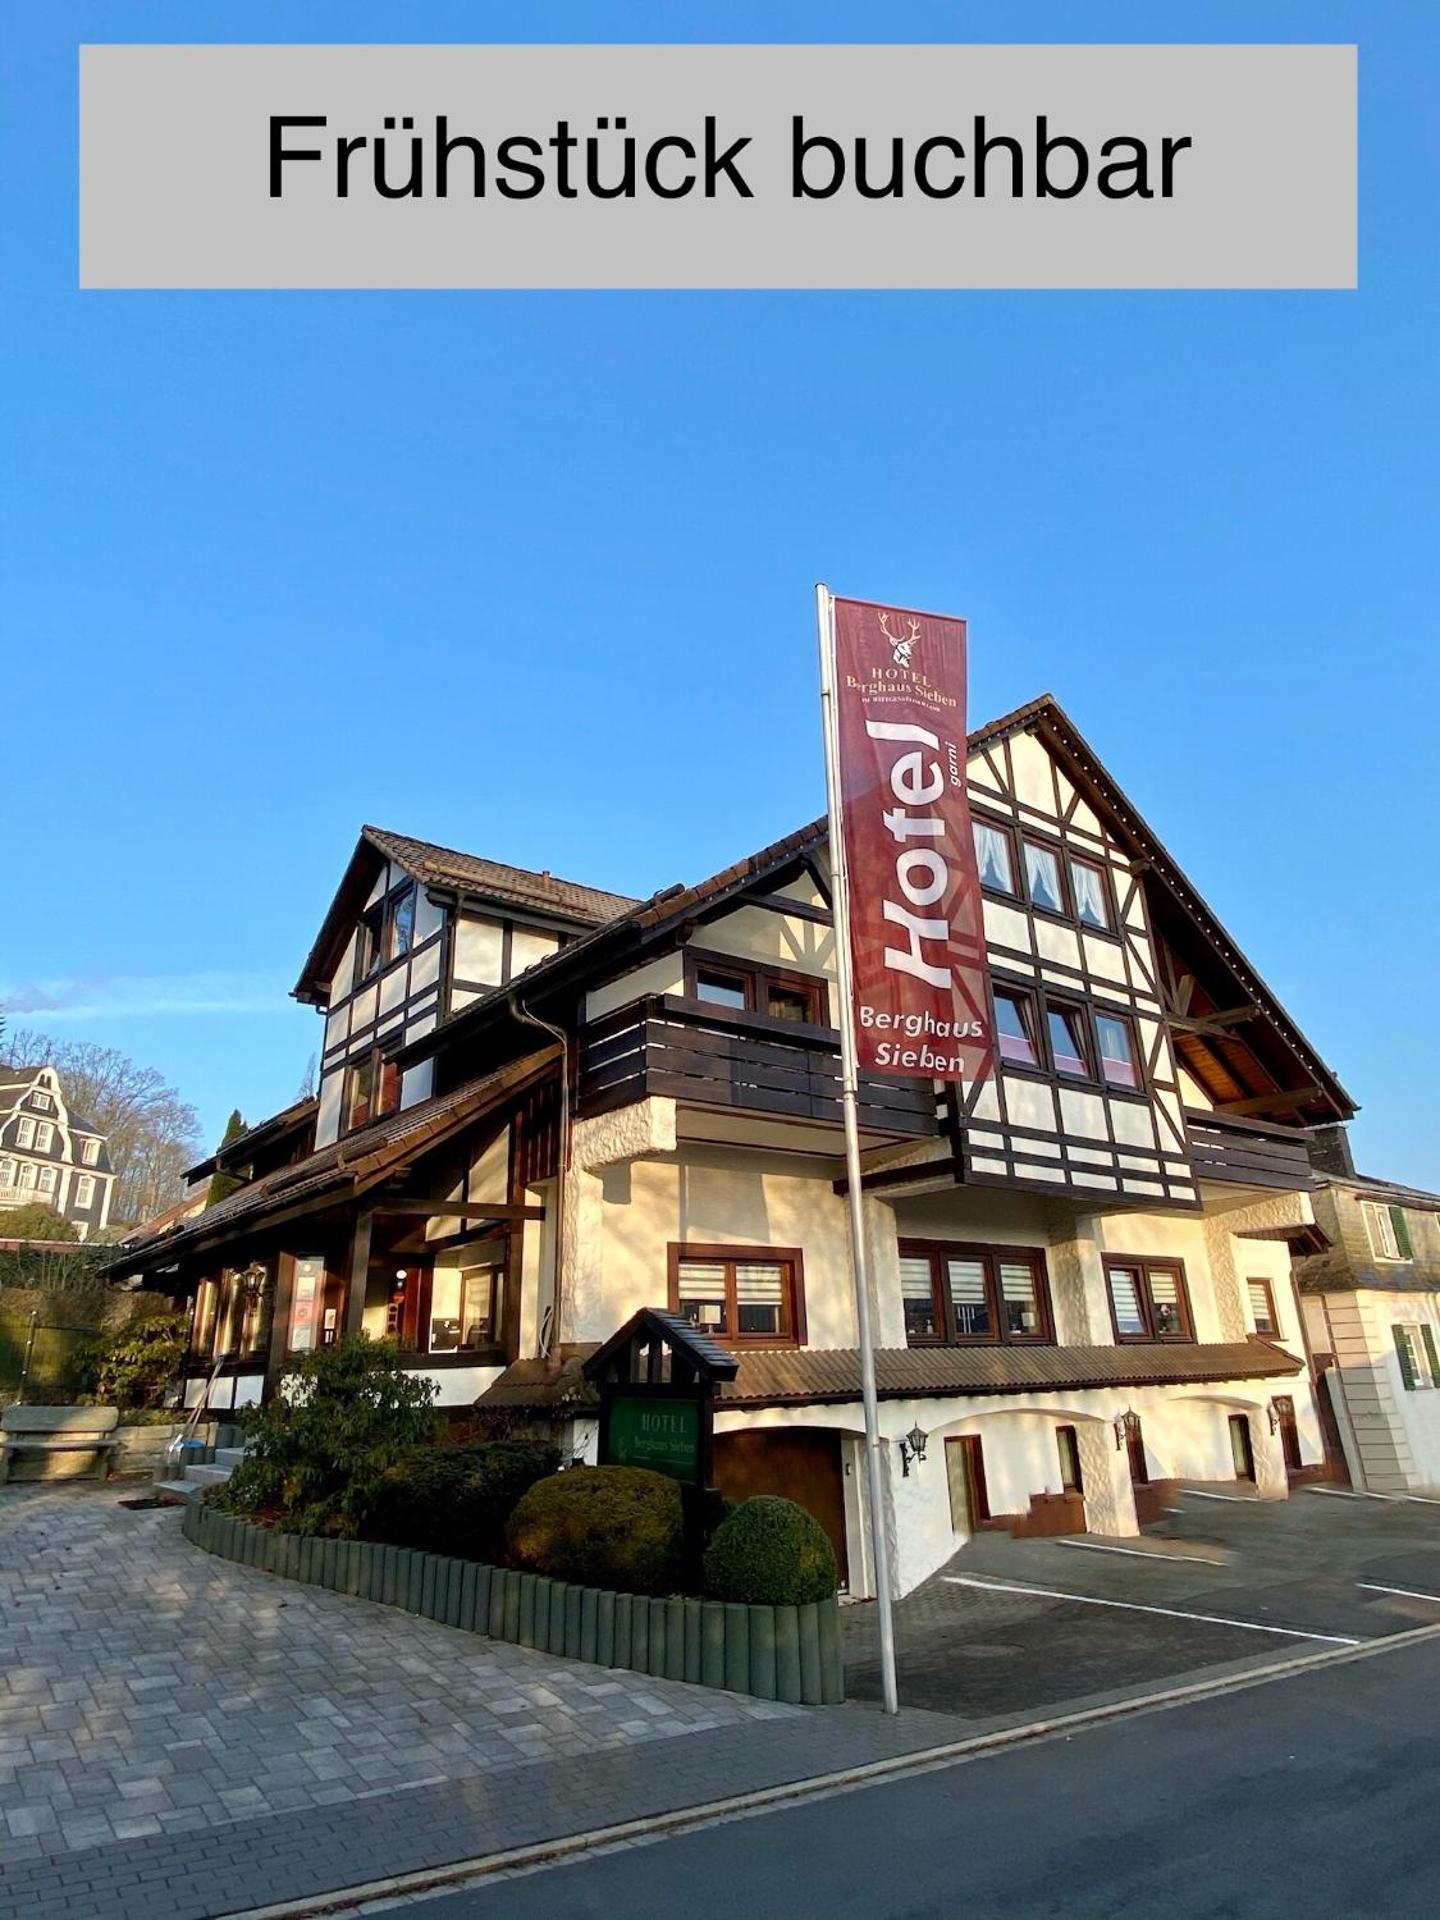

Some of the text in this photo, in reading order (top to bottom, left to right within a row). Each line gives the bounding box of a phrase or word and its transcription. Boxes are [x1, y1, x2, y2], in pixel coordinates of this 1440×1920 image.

[846, 675, 912, 696] Berghaus
[914, 684, 957, 708] Sieben
[871, 667, 931, 688] HOTEL
[944, 740, 962, 788] garni
[864, 719, 951, 989] Hotel
[859, 1005, 985, 1038] Berghaus
[874, 1042, 966, 1073] Sieben
[641, 1412, 688, 1433] HOTEL
